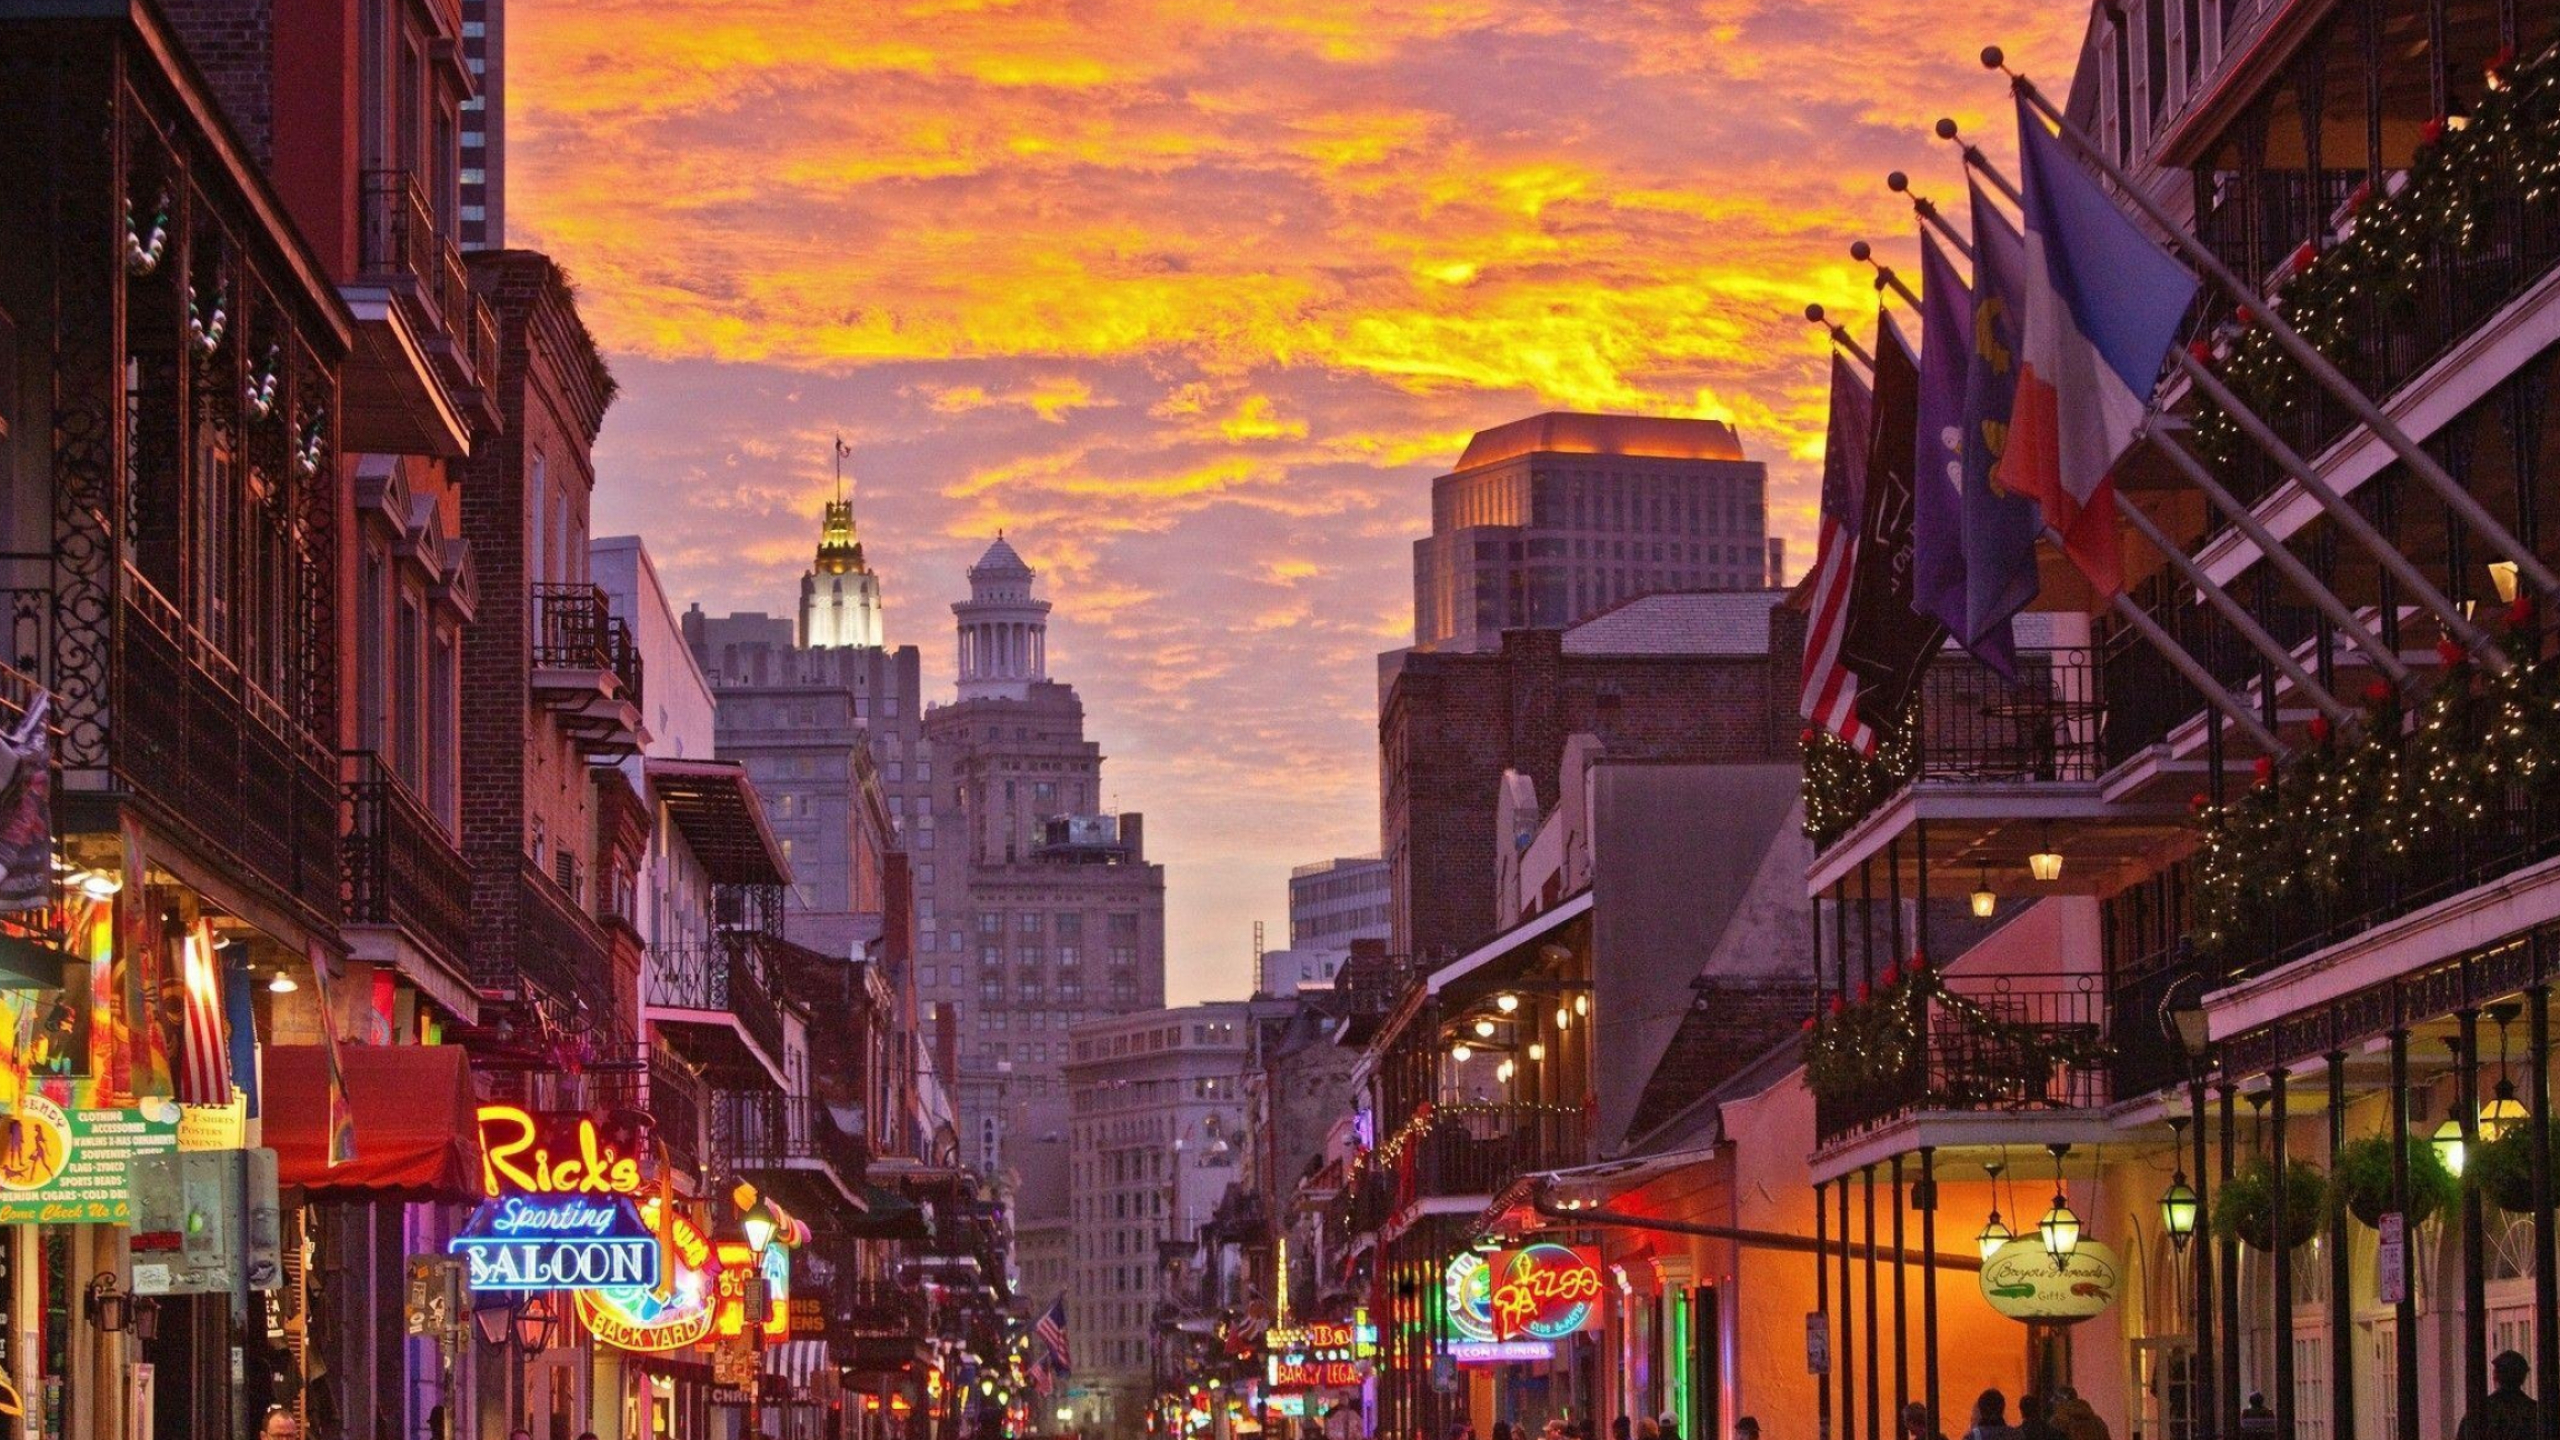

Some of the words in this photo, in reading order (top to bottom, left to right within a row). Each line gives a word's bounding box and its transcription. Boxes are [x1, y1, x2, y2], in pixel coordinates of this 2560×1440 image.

[77, 1111, 123, 1122] CLOTHING
[477, 1106, 640, 1197] Rick's
[59, 1176, 92, 1187] SPORTS
[41, 1189, 77, 1201] CIGARS
[82, 1188, 108, 1200] COLD
[0, 1204, 36, 1221] Come
[40, 1203, 82, 1221] Check
[494, 1198, 616, 1235] Sporting
[468, 1243, 645, 1284] SALOON
[790, 1299, 821, 1314] RIS
[591, 1311, 643, 1347] BACK
[650, 1318, 699, 1347] YARD
[790, 1315, 826, 1331] ENS
[1448, 1347, 1498, 1358] LCONY
